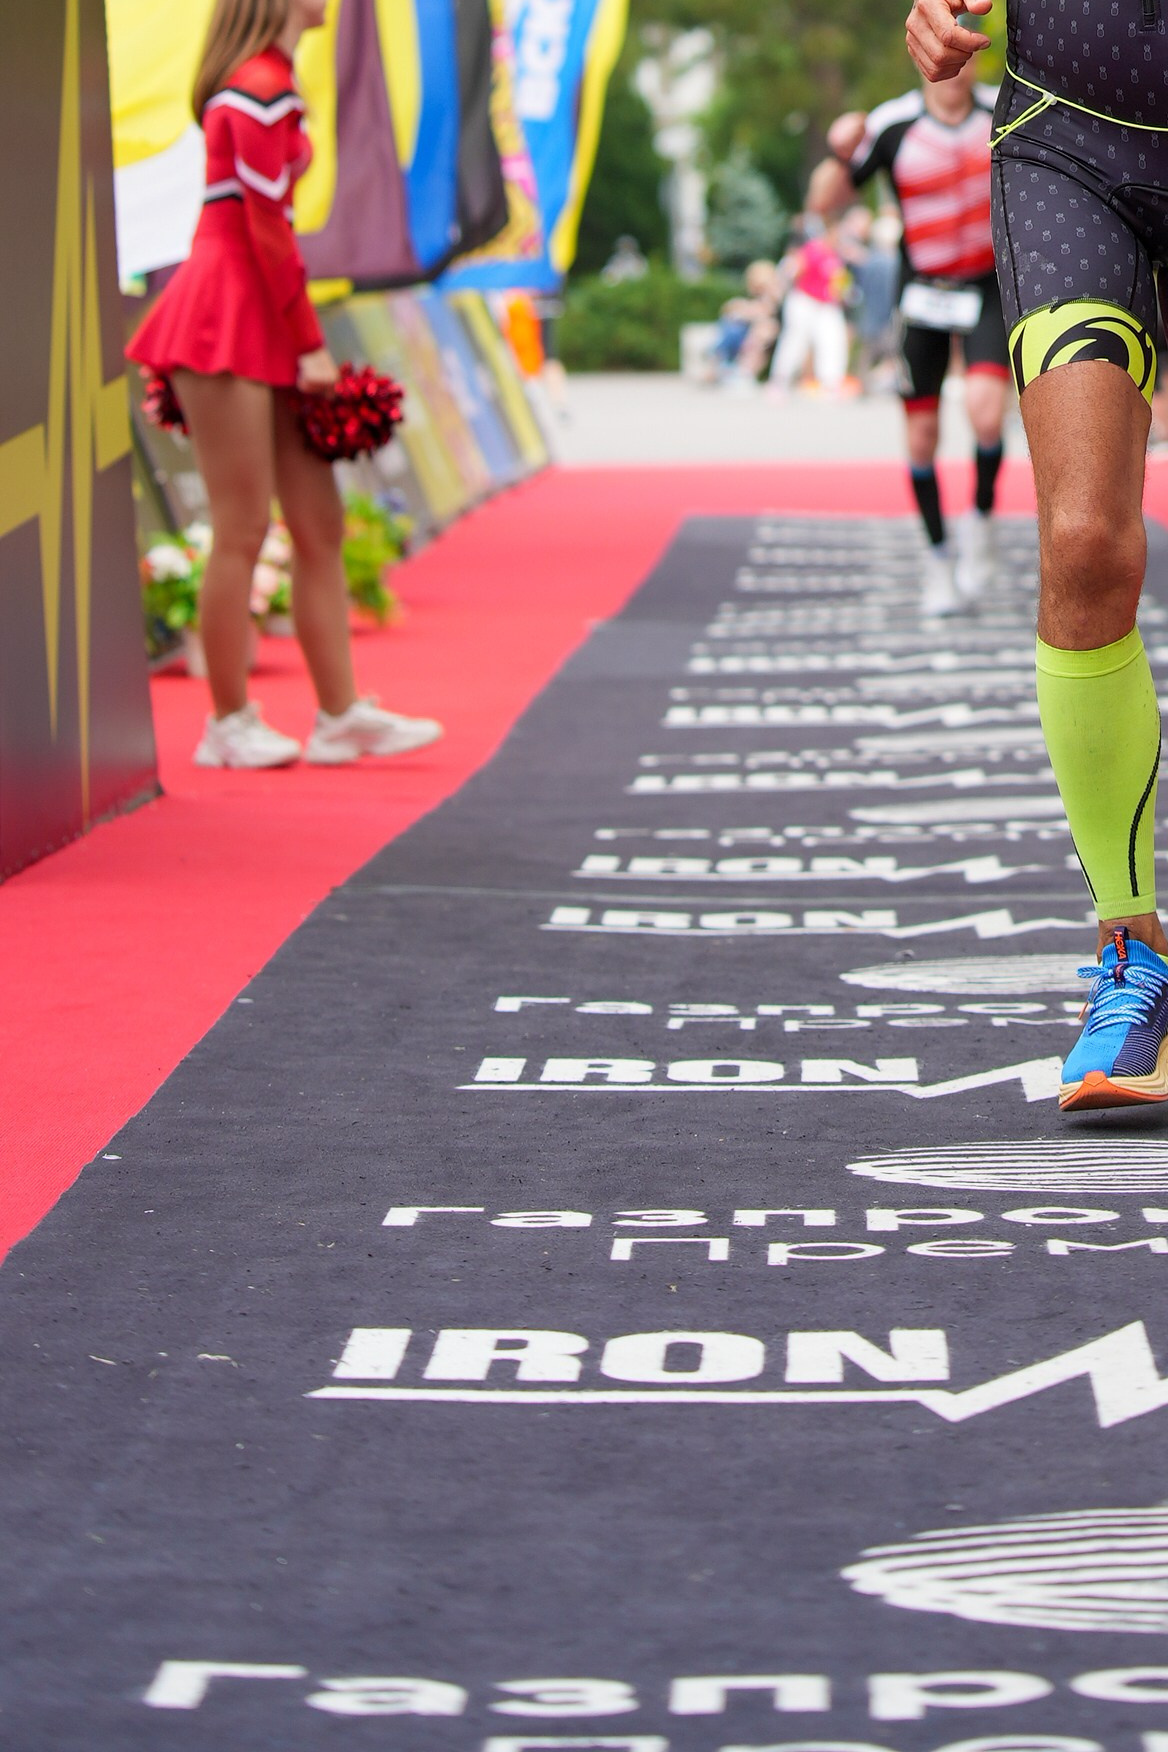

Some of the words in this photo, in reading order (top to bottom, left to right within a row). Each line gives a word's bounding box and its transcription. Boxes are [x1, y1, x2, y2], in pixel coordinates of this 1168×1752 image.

[549, 906, 898, 930] IRON
[1114, 931, 1127, 959] HOKA
[473, 1056, 919, 1083] IRON
[331, 1327, 951, 1384] IRON
